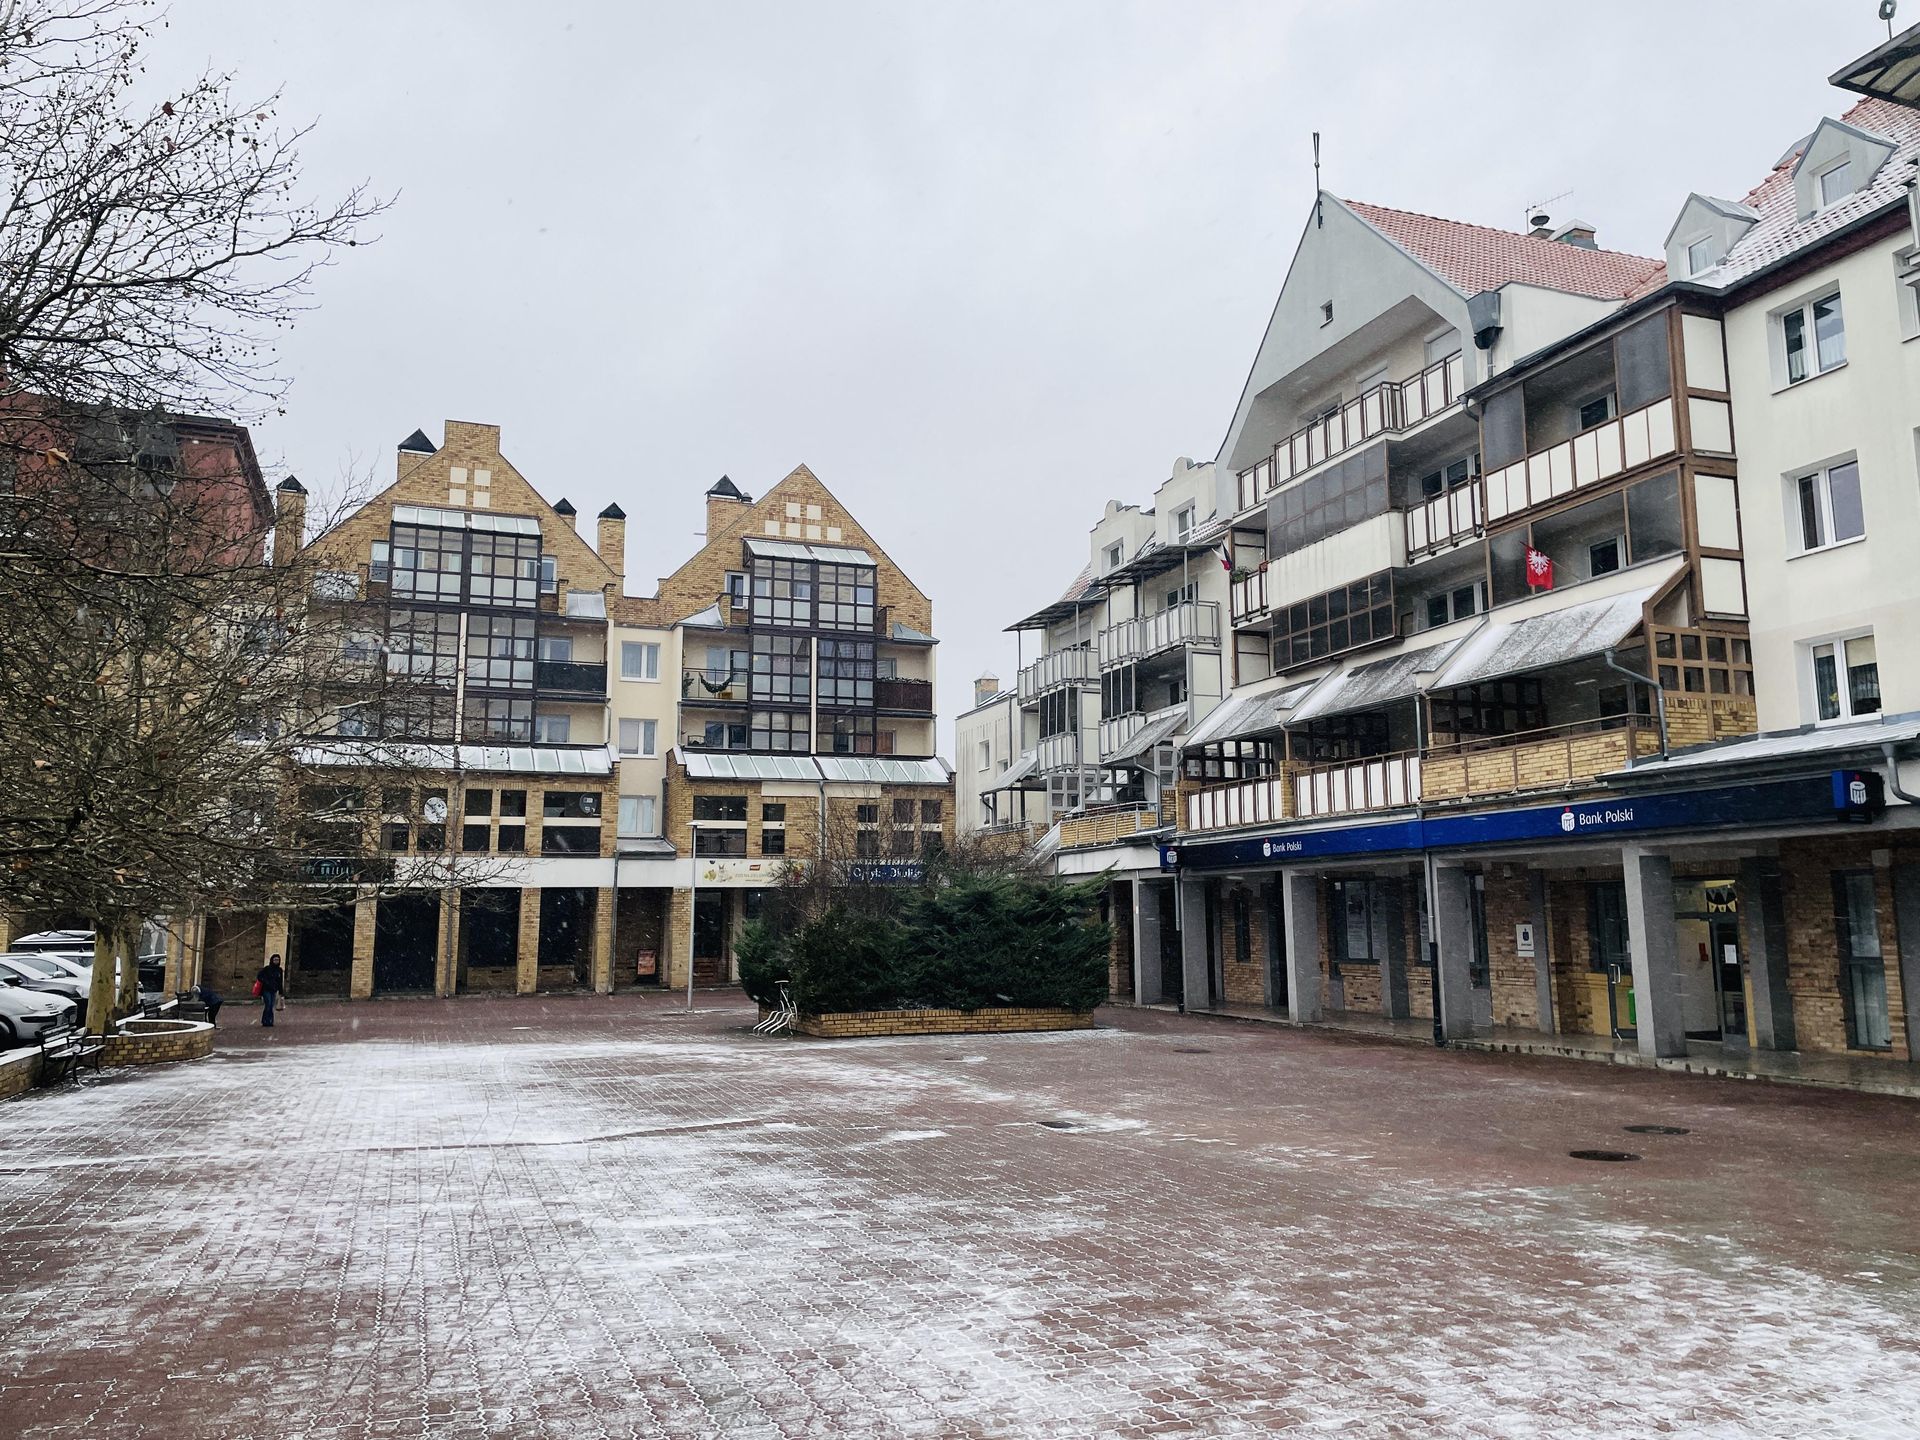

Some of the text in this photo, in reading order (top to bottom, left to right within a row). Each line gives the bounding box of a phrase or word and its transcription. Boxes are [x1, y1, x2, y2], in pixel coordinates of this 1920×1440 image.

[1579, 811, 1603, 826] Bank
[1605, 808, 1634, 823] Polski
[1272, 842, 1285, 853] Bank
[1286, 841, 1302, 851] Polski
